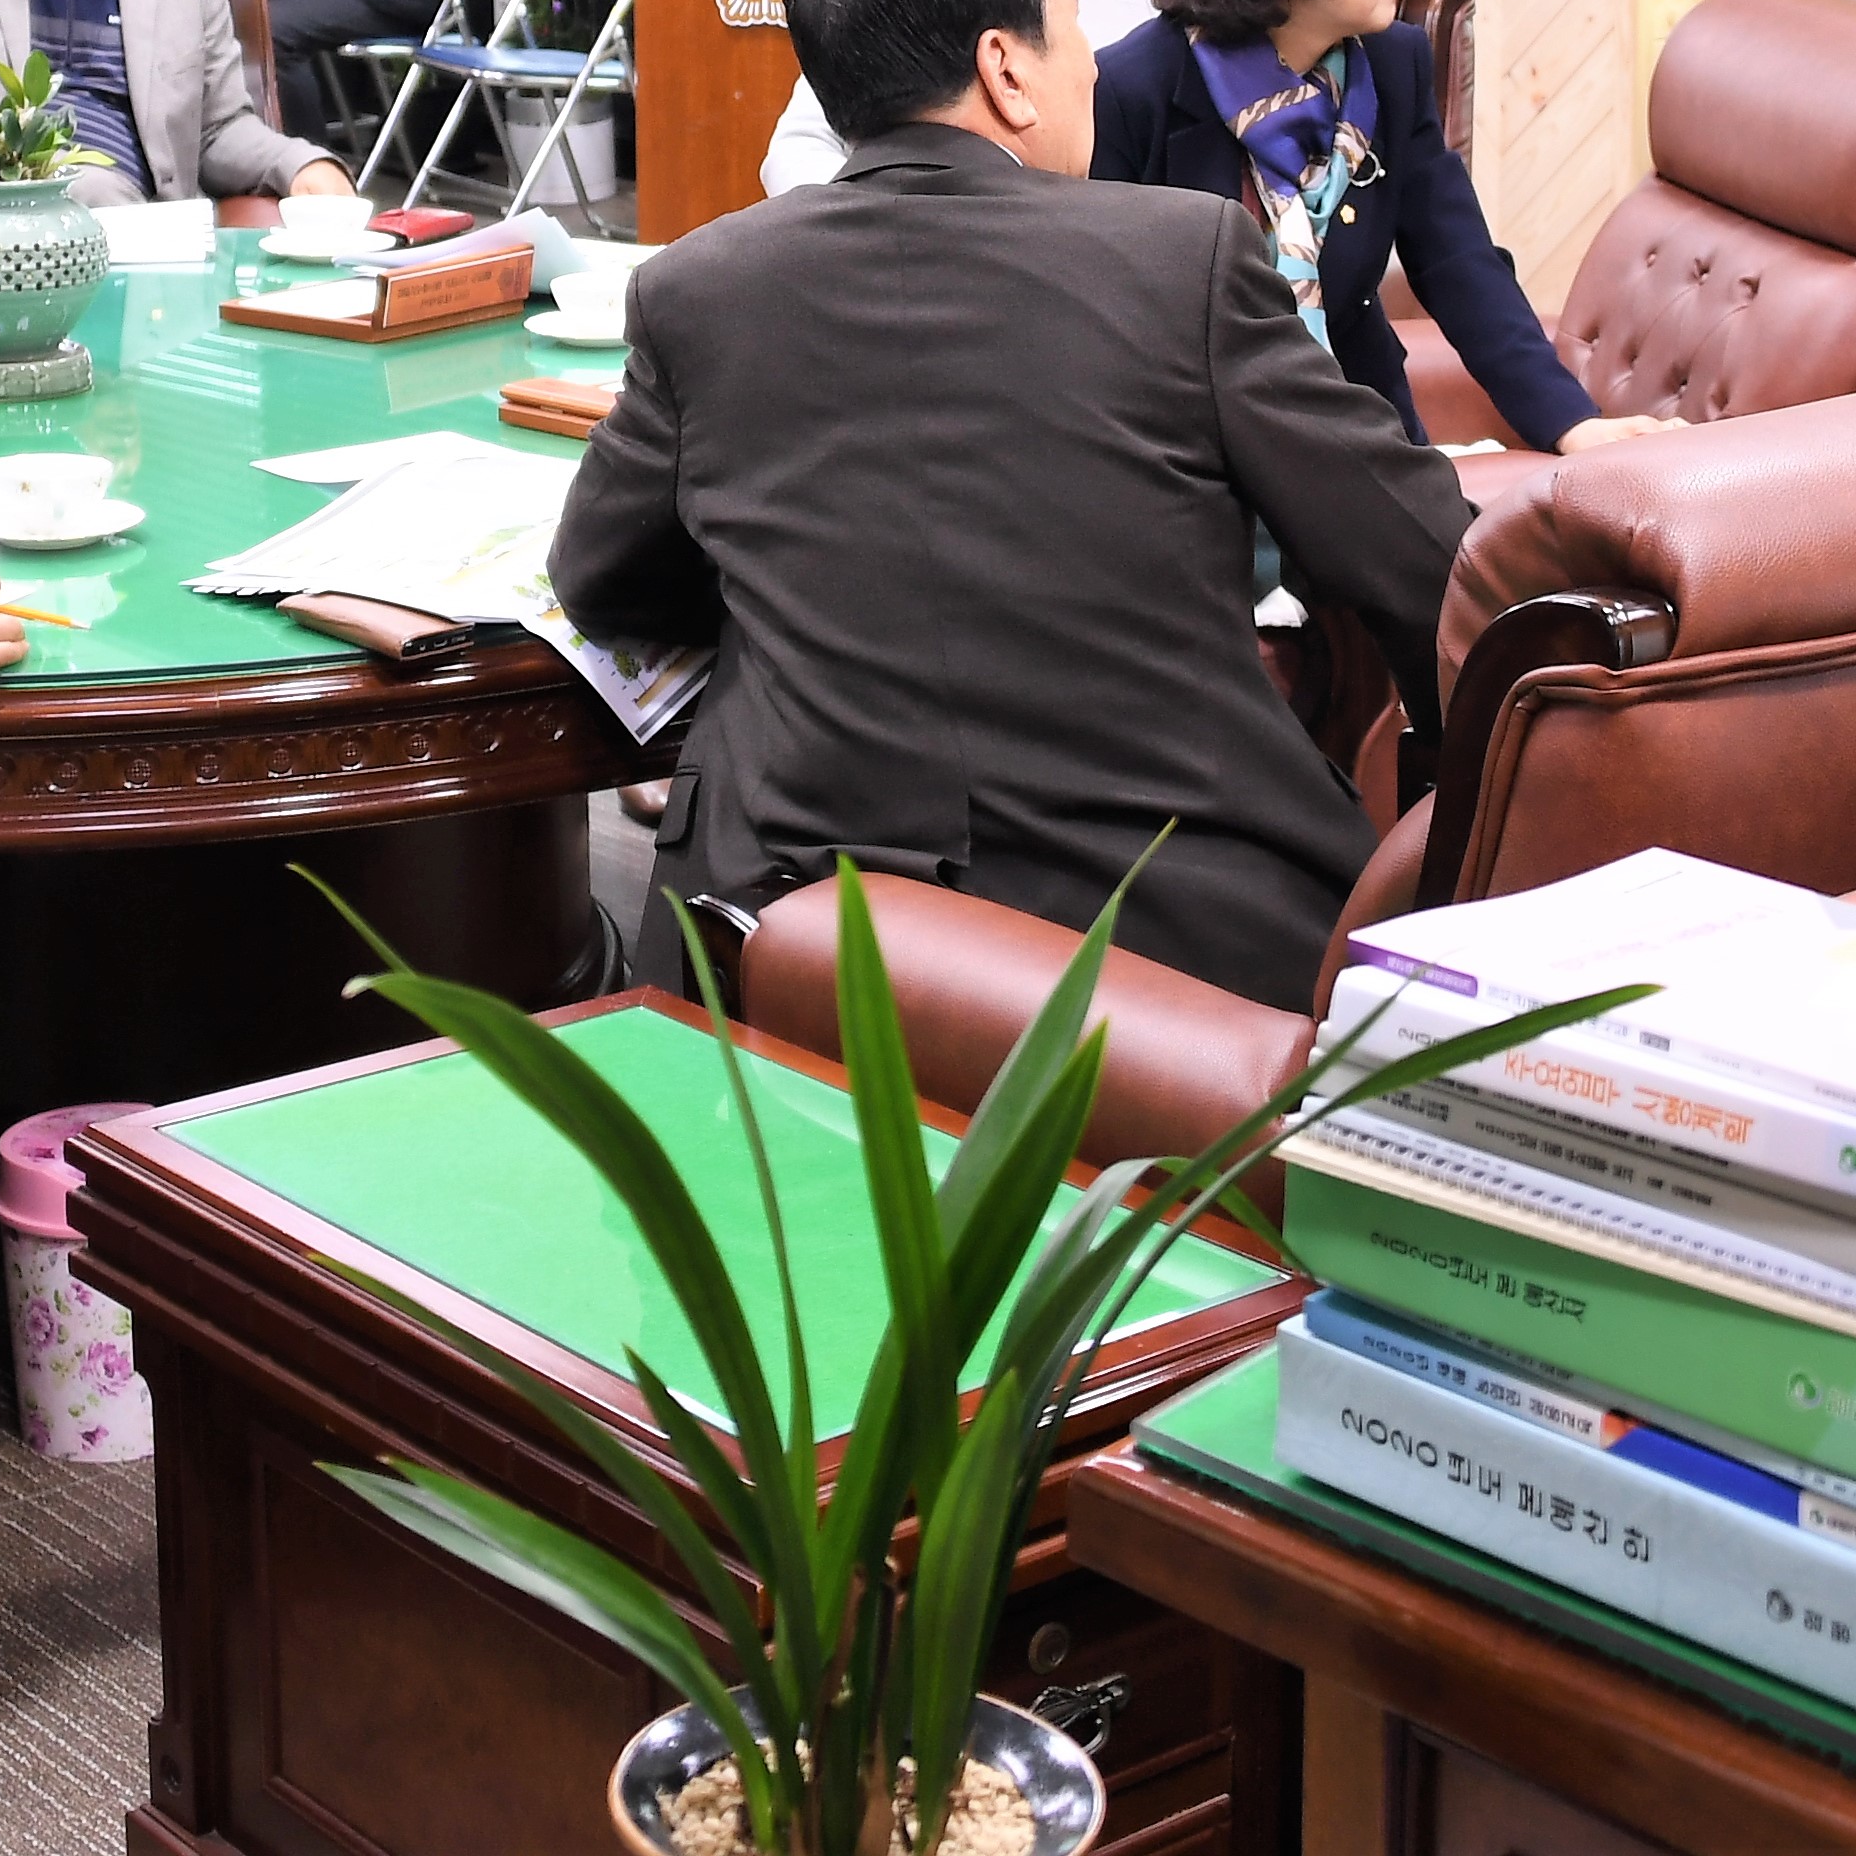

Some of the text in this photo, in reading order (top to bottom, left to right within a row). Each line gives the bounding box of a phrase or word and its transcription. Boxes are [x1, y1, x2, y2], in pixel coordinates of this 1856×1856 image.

[1505, 1049, 1620, 1107] 주요업무
[1634, 1085, 1754, 1144] 시행계획
[1371, 1231, 1489, 1289] 2020년도
[1340, 1406, 1503, 1502] 2020년도
